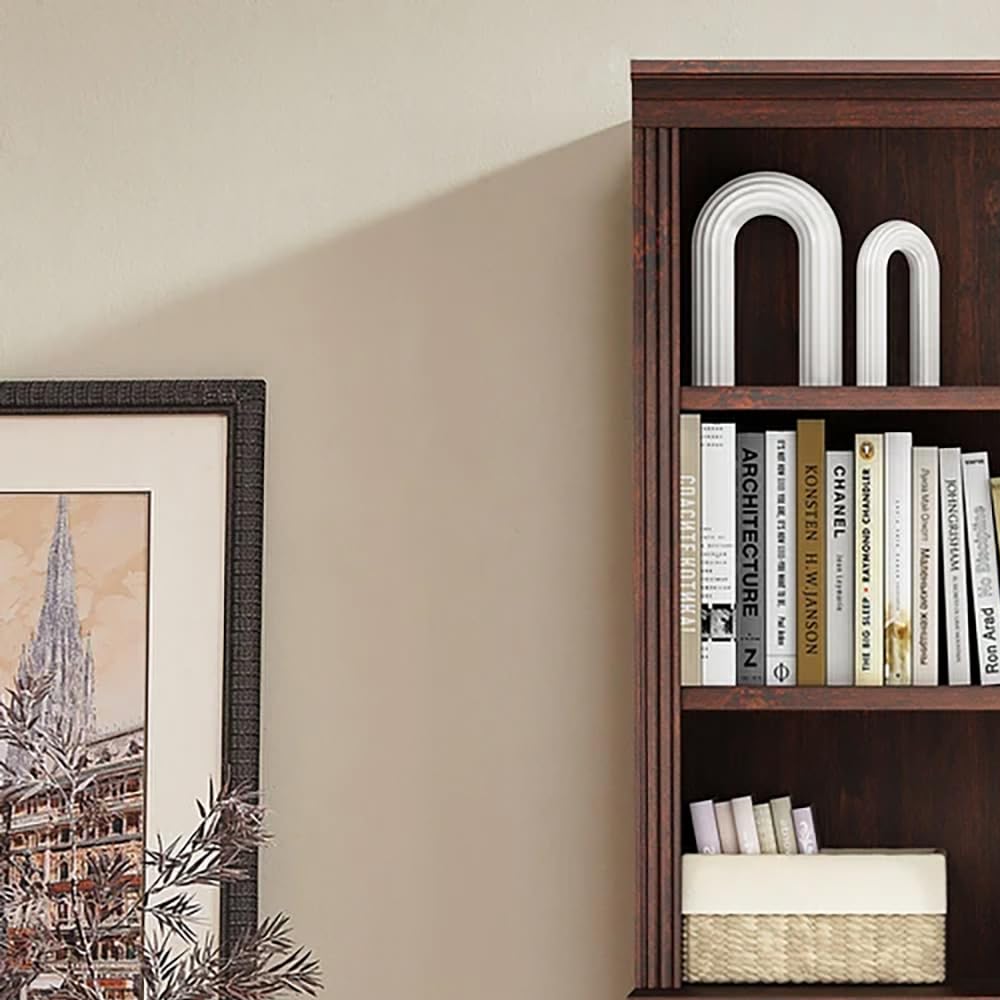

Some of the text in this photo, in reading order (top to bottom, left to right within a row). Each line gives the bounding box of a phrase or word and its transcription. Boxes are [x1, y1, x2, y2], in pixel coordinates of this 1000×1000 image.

[742, 447, 759, 616] ARCHITECTURE
[804, 464, 818, 541] KONSTEN
[833, 465, 847, 538] CHANEL
[861, 468, 871, 671] THE BIG SLEEP RAYMOND CHANDLER
[919, 547, 931, 610] Маленькие
[976, 576, 993, 599] No
[918, 611, 930, 665] женщины
[979, 608, 997, 641] Arad
[985, 646, 1000, 674] Ron
